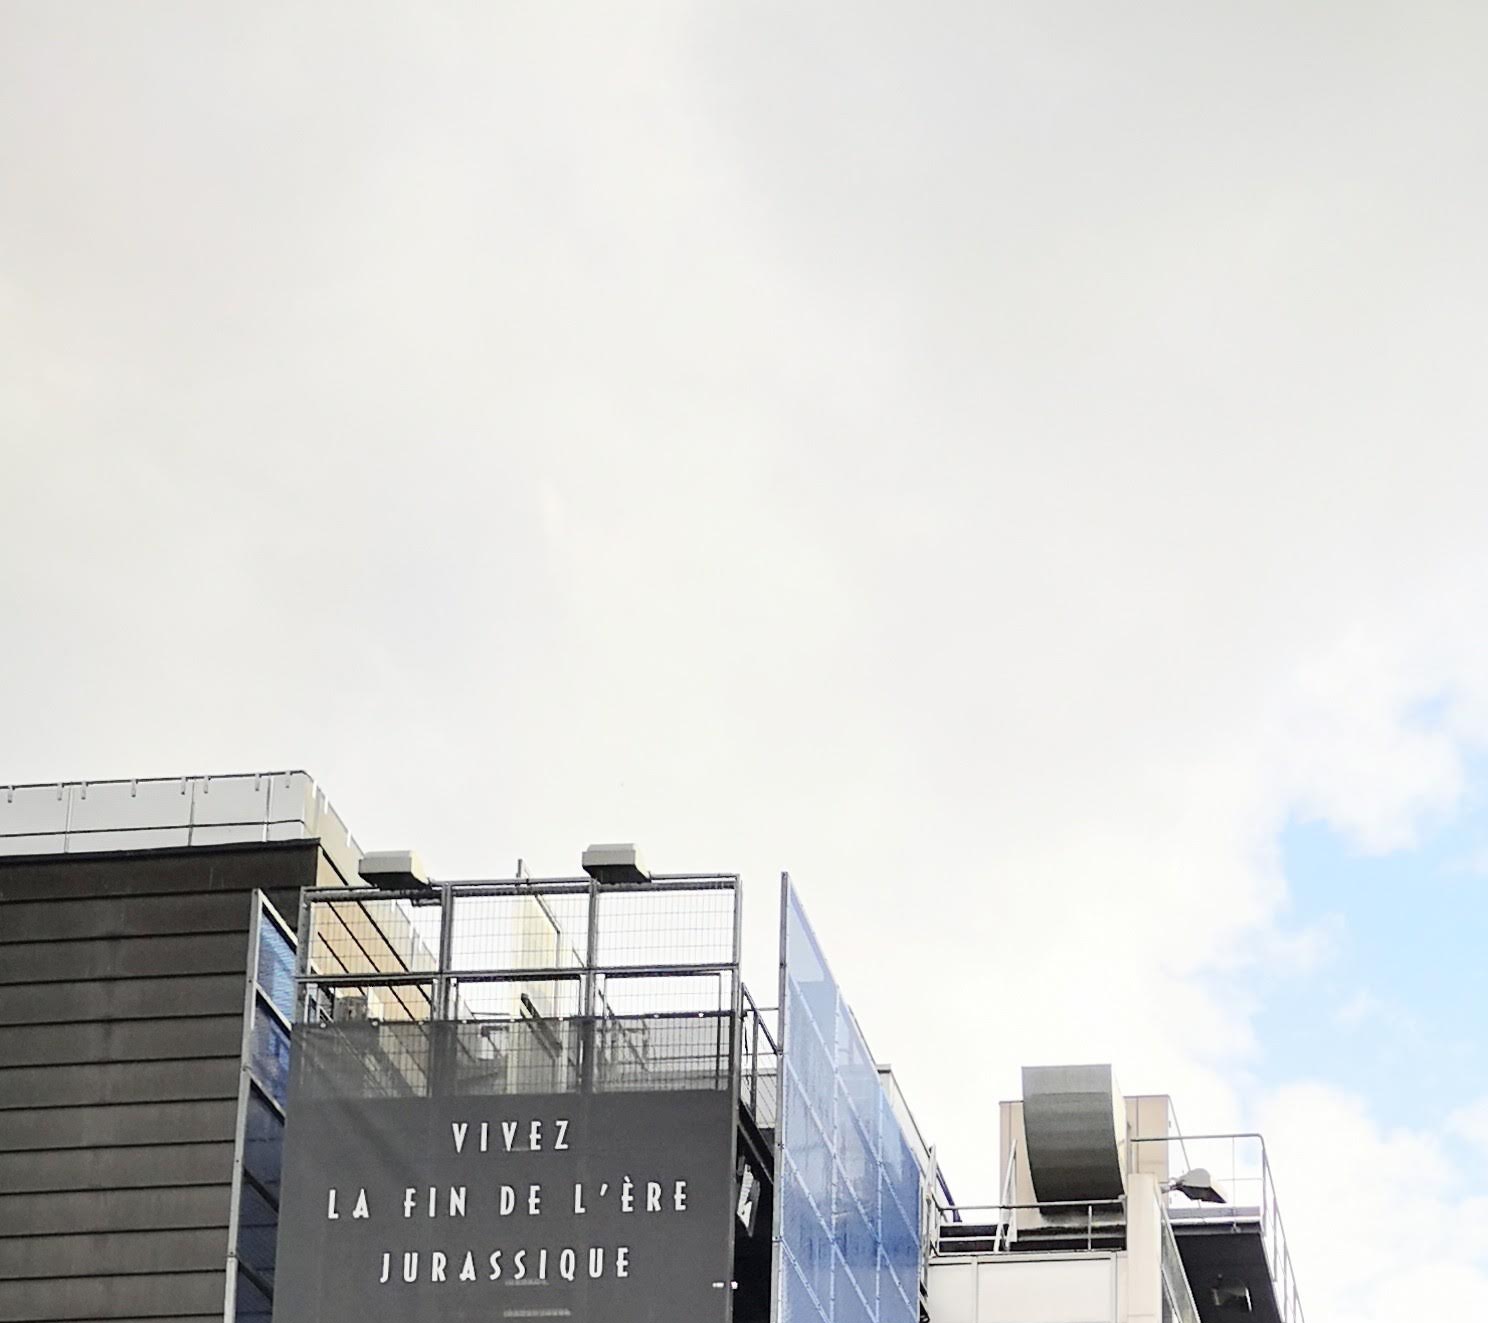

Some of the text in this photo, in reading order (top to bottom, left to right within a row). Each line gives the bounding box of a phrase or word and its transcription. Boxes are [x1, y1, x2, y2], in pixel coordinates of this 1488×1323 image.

[452, 1120, 571, 1153] VIVEZ
[327, 1176, 689, 1220] LA FIN DE L'ÈRE
[380, 1246, 631, 1284] JURASSIQUE
